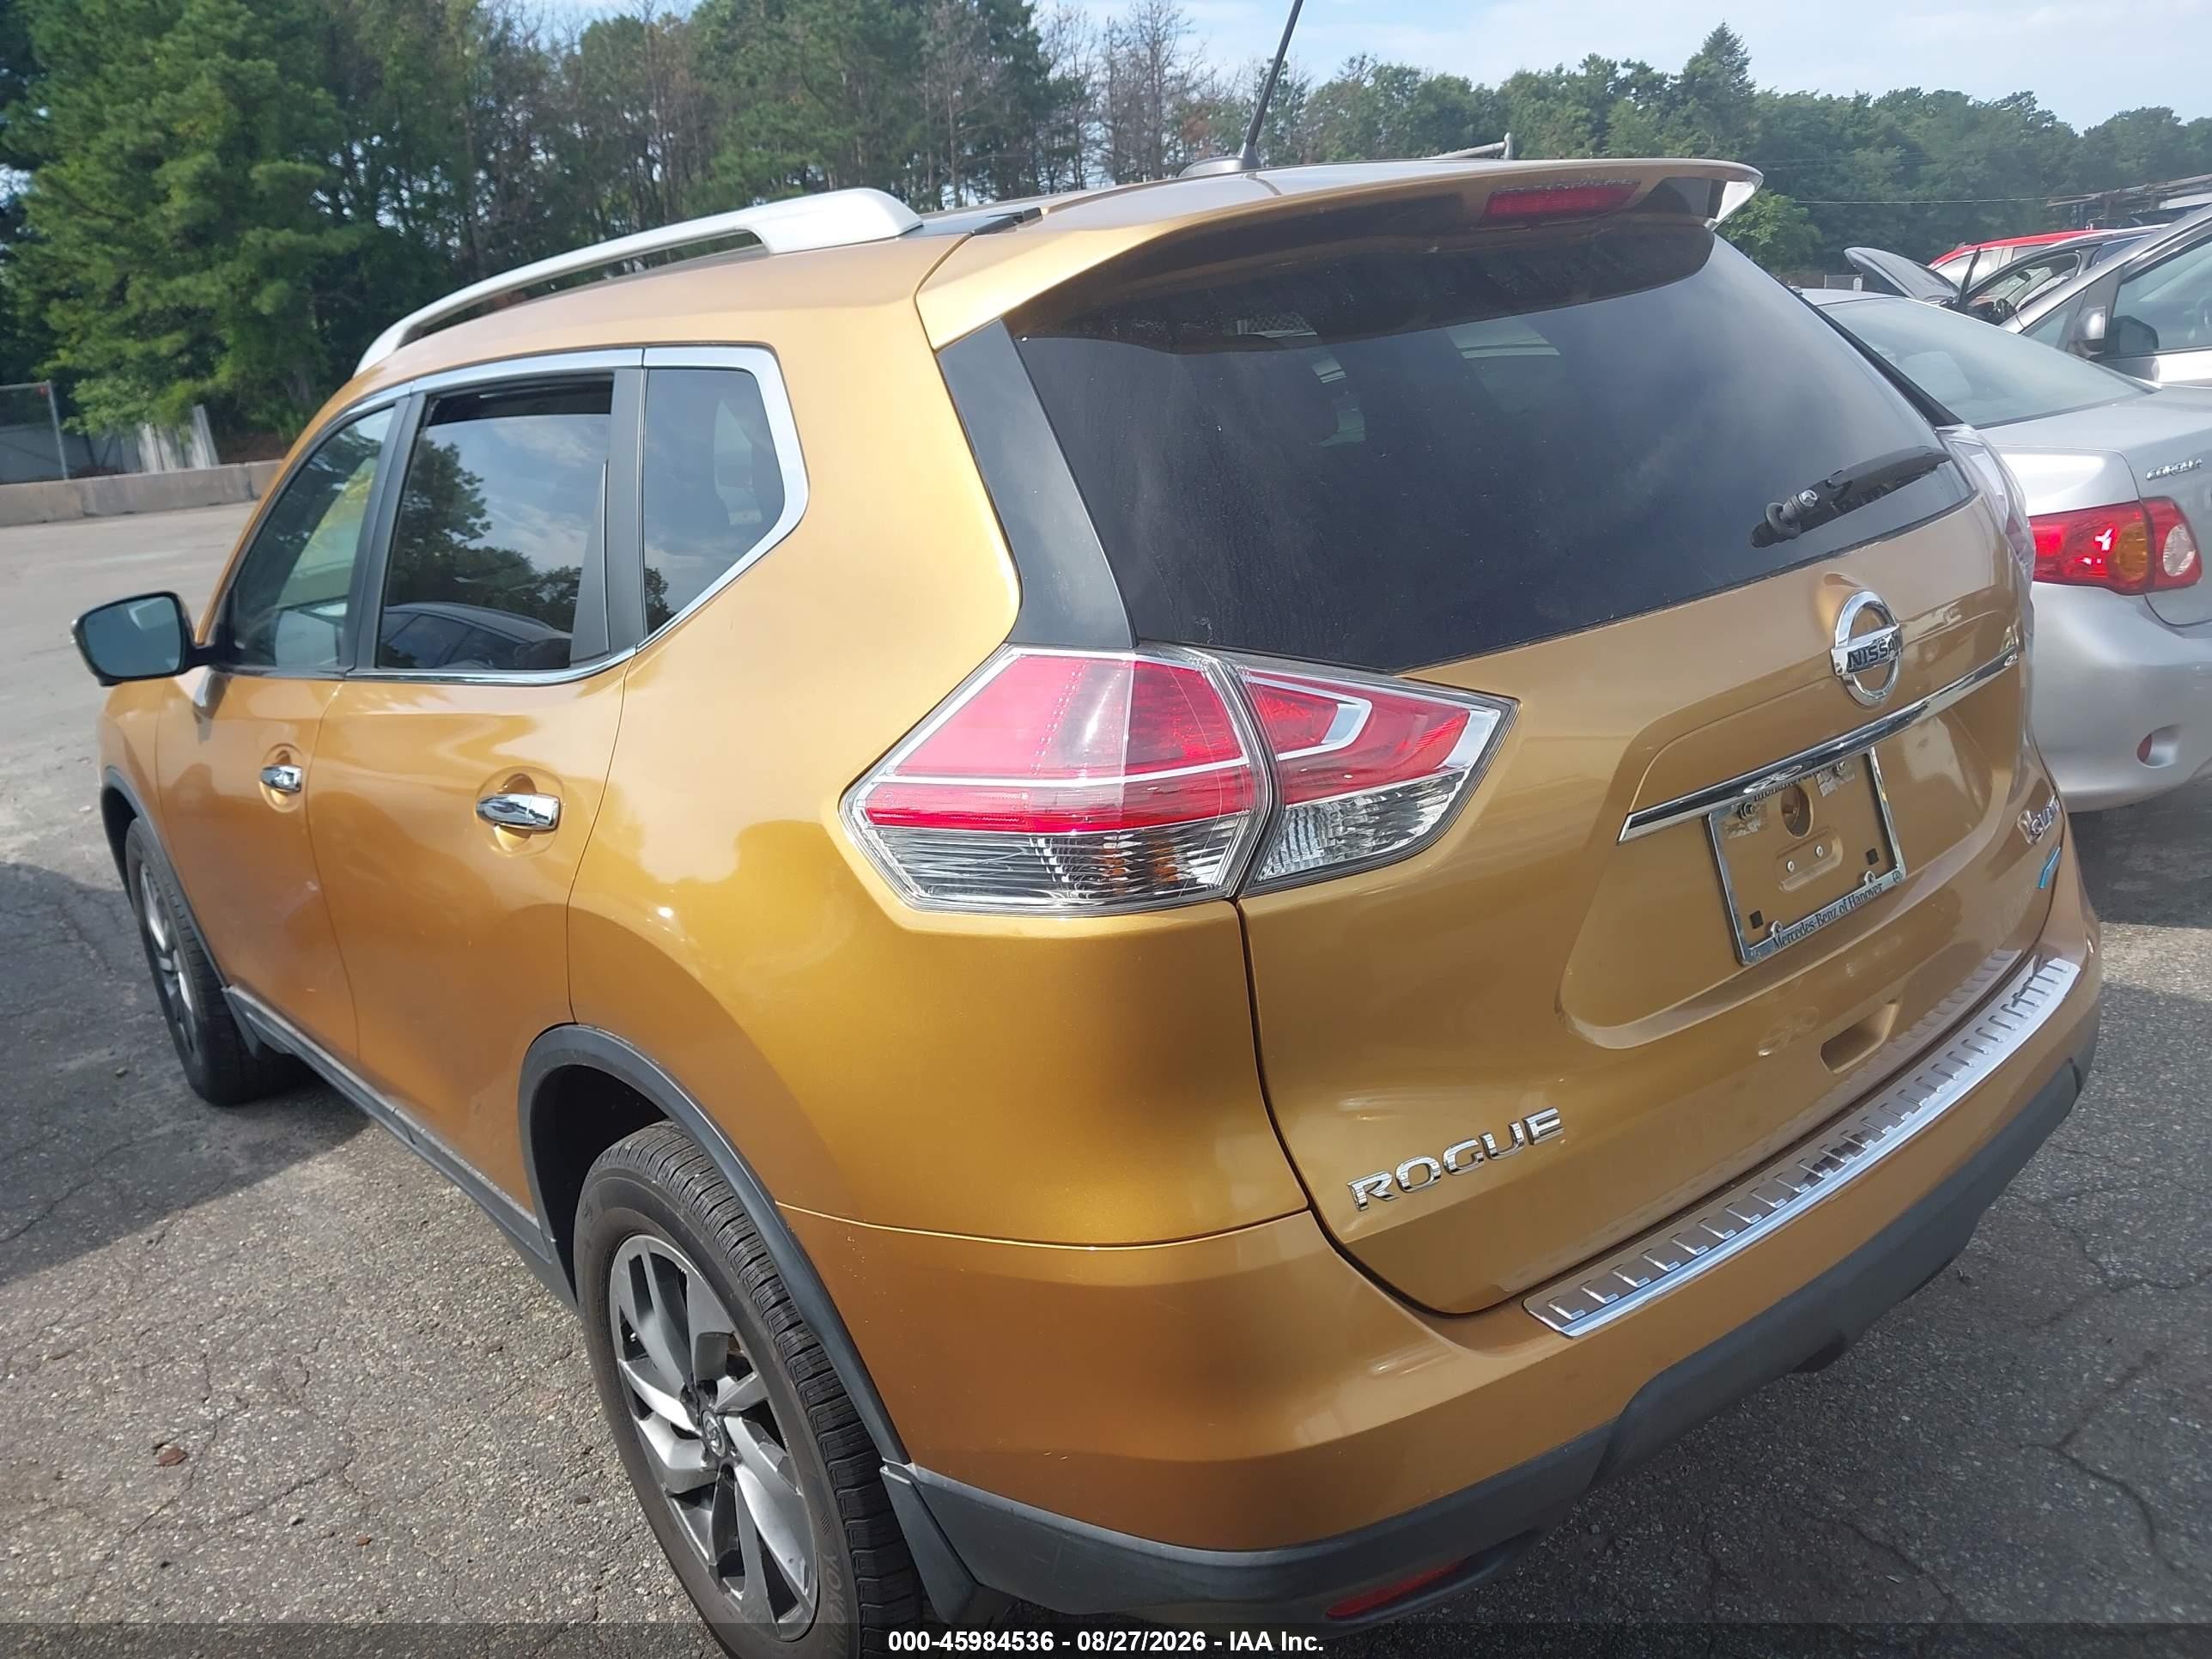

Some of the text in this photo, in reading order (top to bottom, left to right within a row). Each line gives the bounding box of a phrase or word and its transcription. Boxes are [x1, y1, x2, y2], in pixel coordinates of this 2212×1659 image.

[1846, 631, 1903, 671] NISSAN
[1772, 883, 1883, 950] Mercedes-Benz of Hanover
[1346, 1106, 1565, 1212] ROGUE
